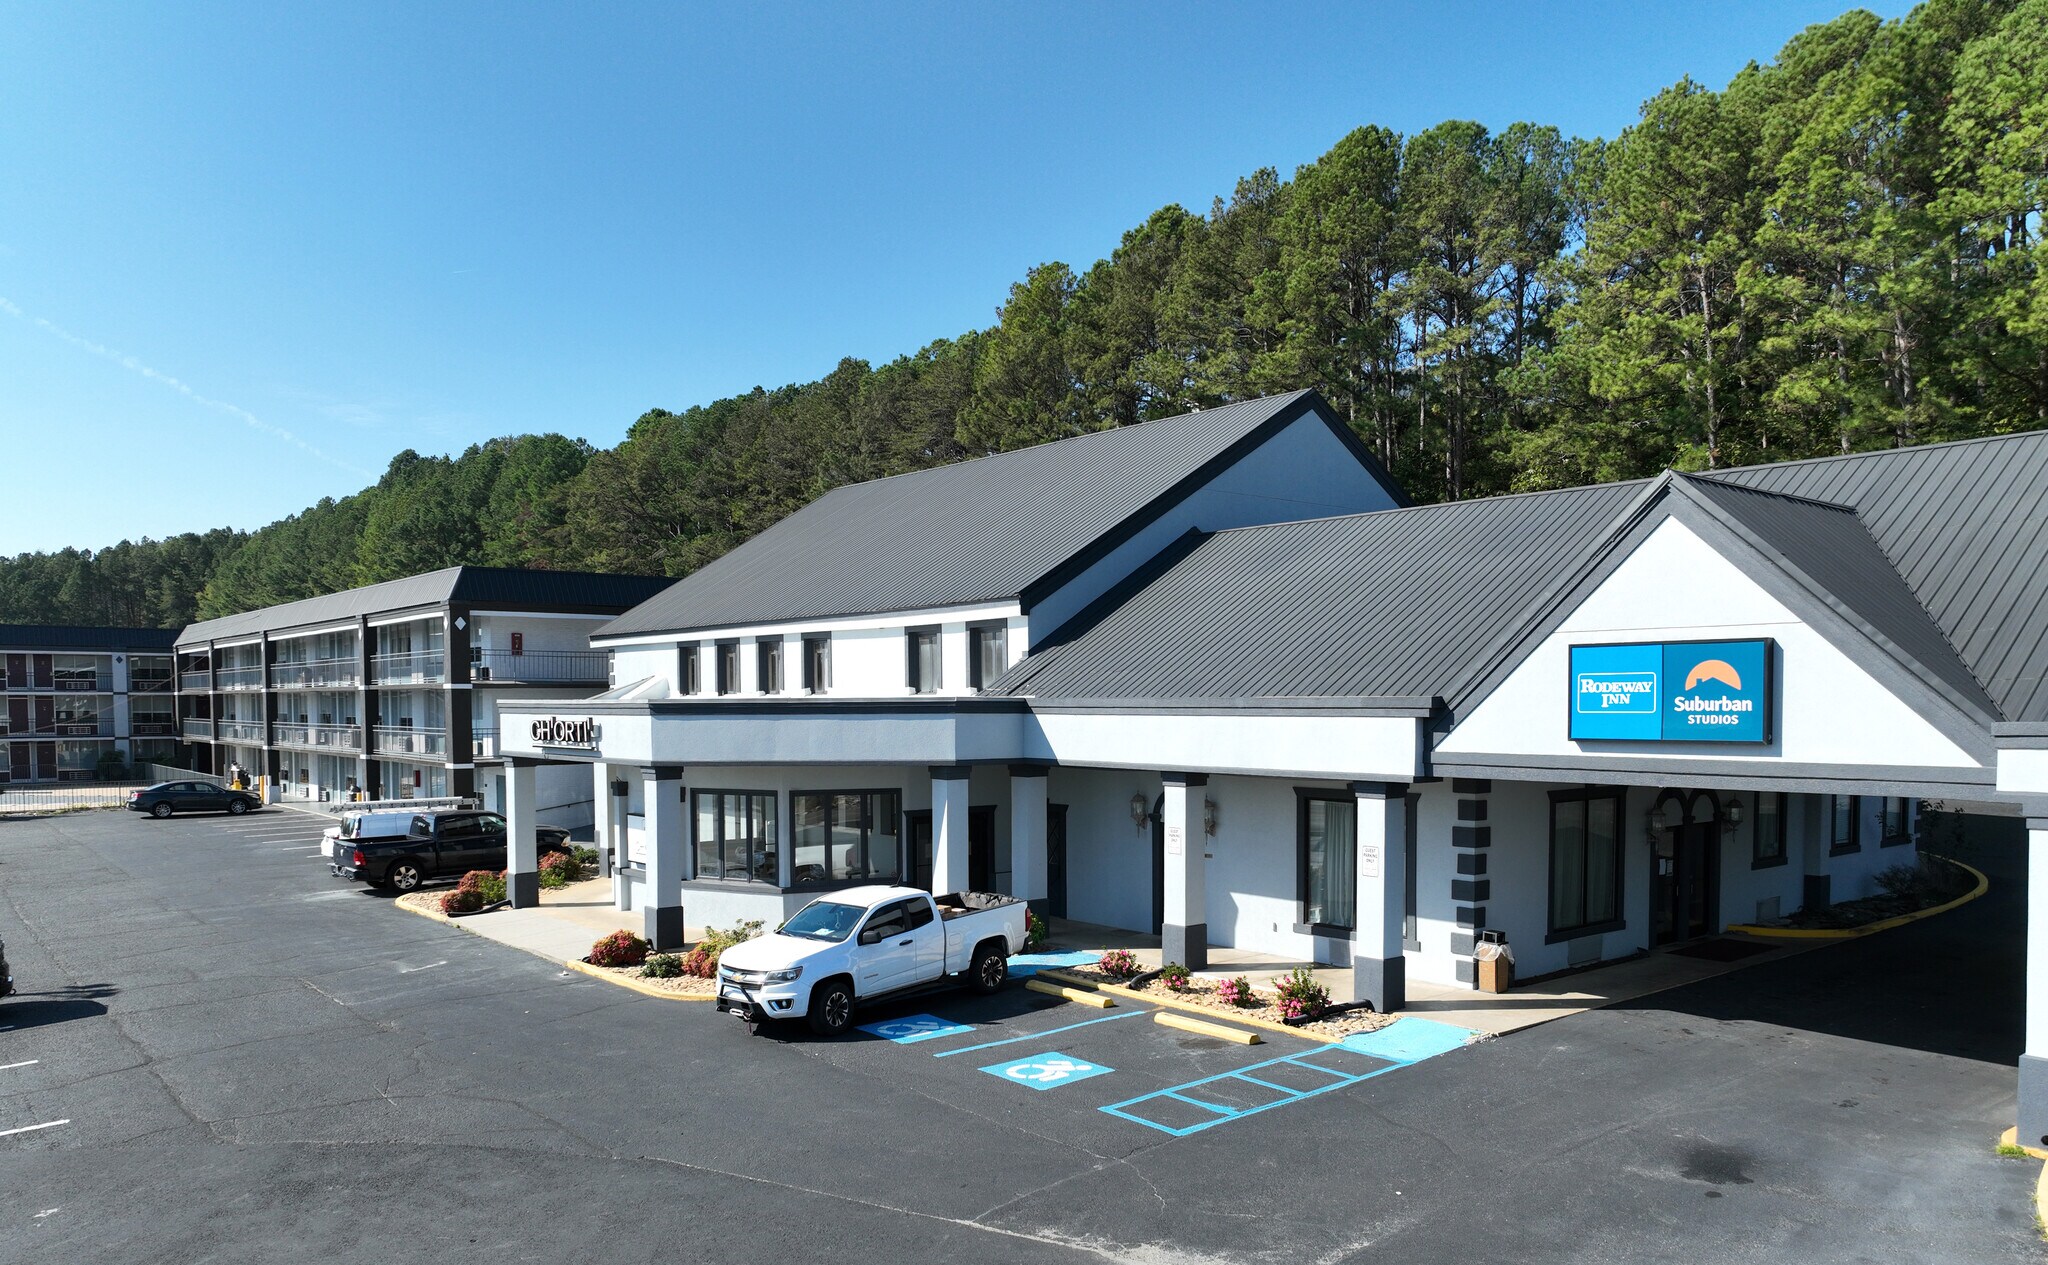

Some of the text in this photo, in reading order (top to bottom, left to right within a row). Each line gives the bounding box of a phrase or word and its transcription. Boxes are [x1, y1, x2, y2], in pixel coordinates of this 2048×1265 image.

[1580, 679, 1653, 693] RODEWAY
[1601, 694, 1630, 708] INN
[1674, 695, 1752, 712] Suburban
[1687, 715, 1739, 725] STUDIOS
